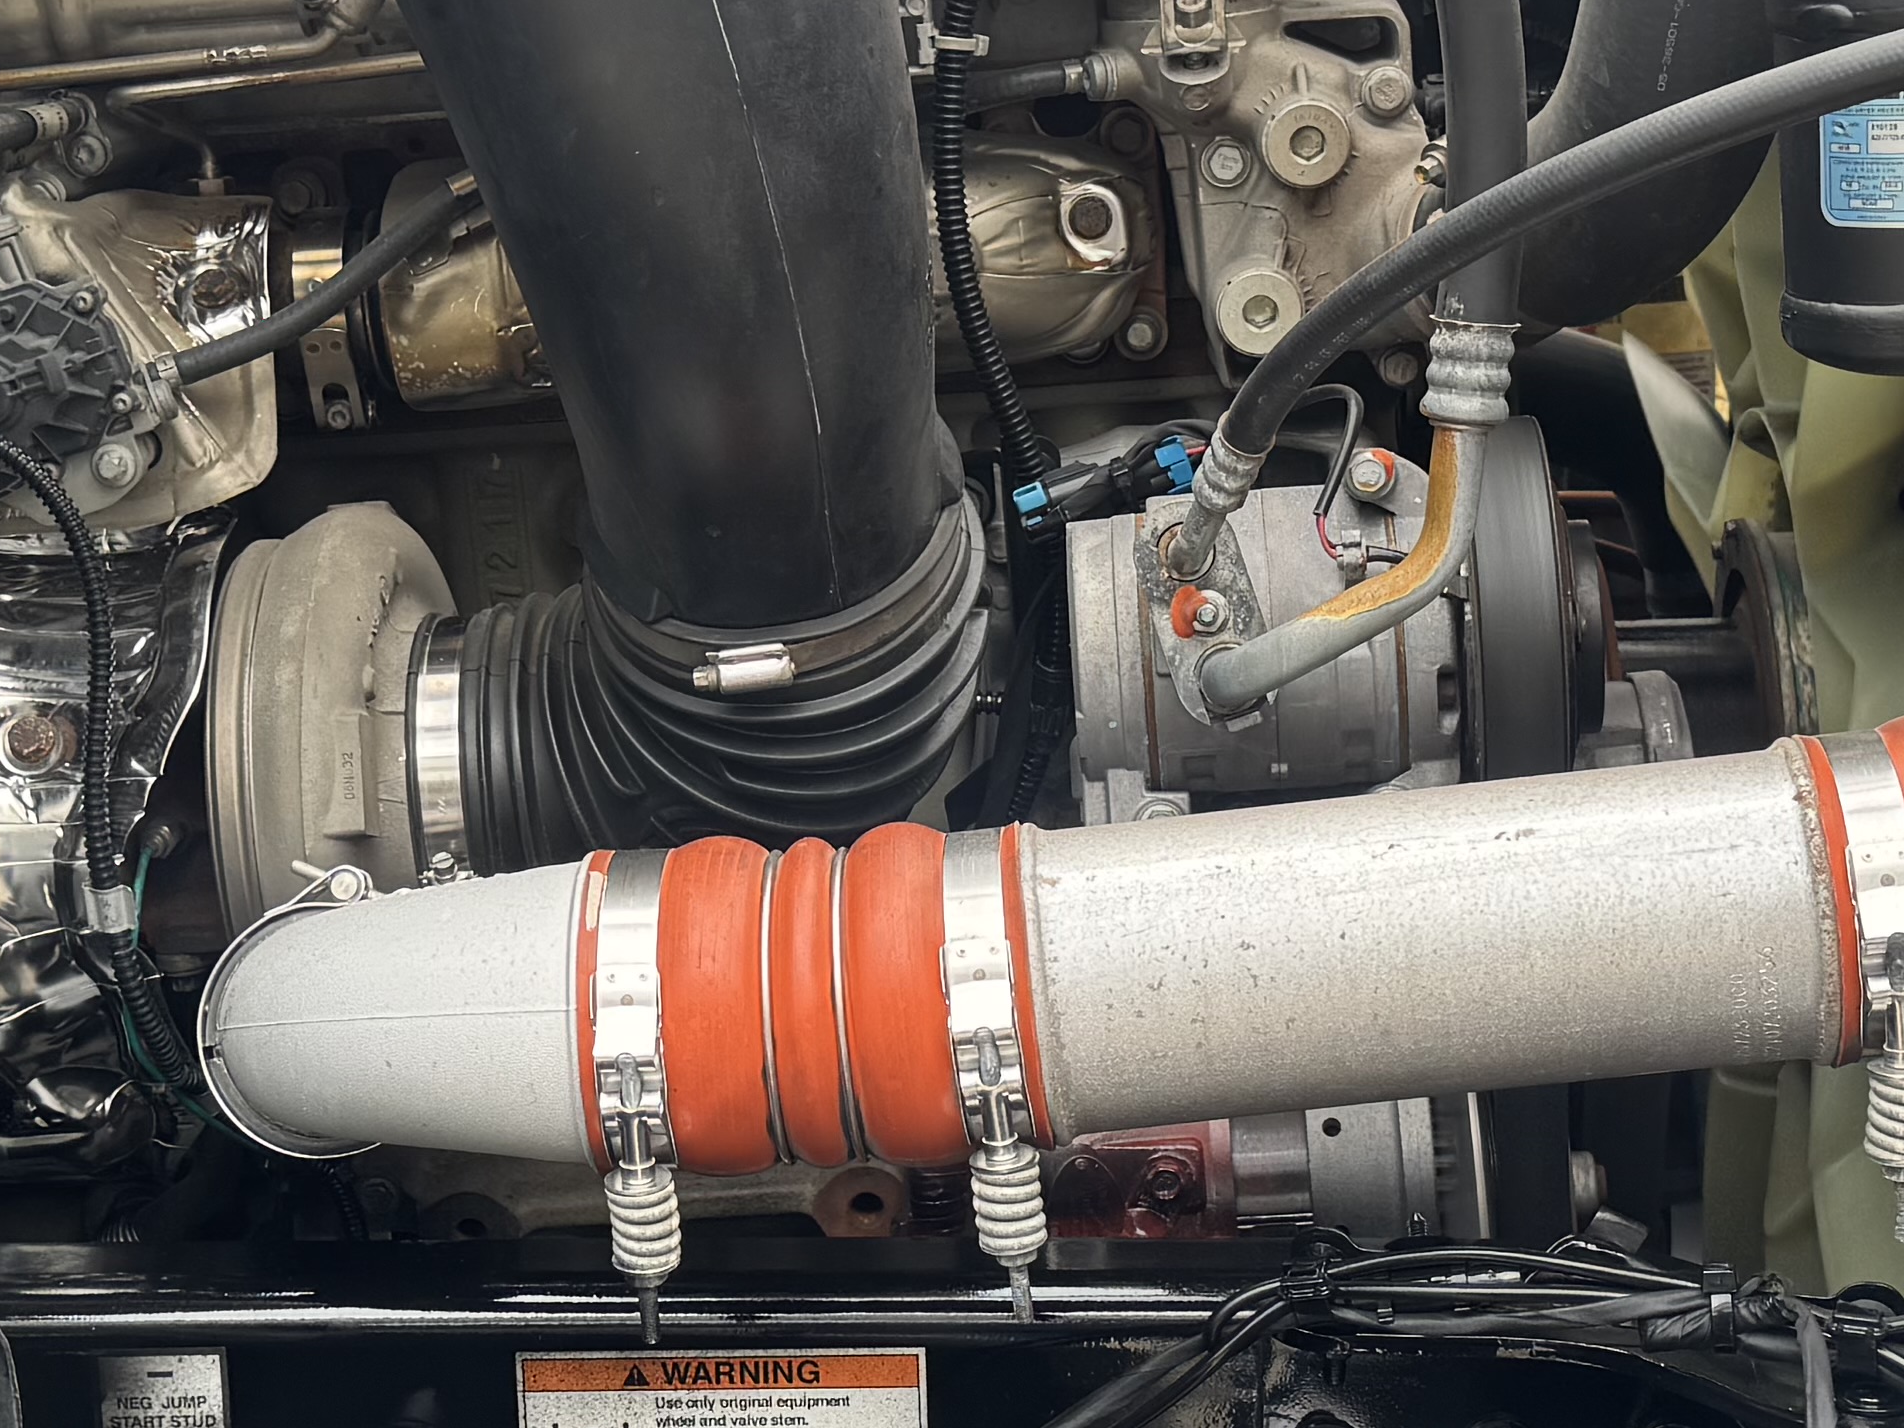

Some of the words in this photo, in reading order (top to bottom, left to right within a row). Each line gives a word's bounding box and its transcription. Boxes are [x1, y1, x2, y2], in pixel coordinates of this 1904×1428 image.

[659, 1359, 822, 1386] WARNING
[116, 1395, 153, 1410] NEG
[161, 1394, 208, 1410] JUMP
[655, 1396, 684, 1410] Use
[685, 1394, 716, 1412] only
[719, 1395, 773, 1412] original
[776, 1394, 851, 1411] equipment
[169, 1413, 218, 1428] STUD
[655, 1413, 697, 1428] wheel
[699, 1413, 727, 1428] and
[730, 1412, 769, 1428] valve
[770, 1412, 809, 1427] stem.
